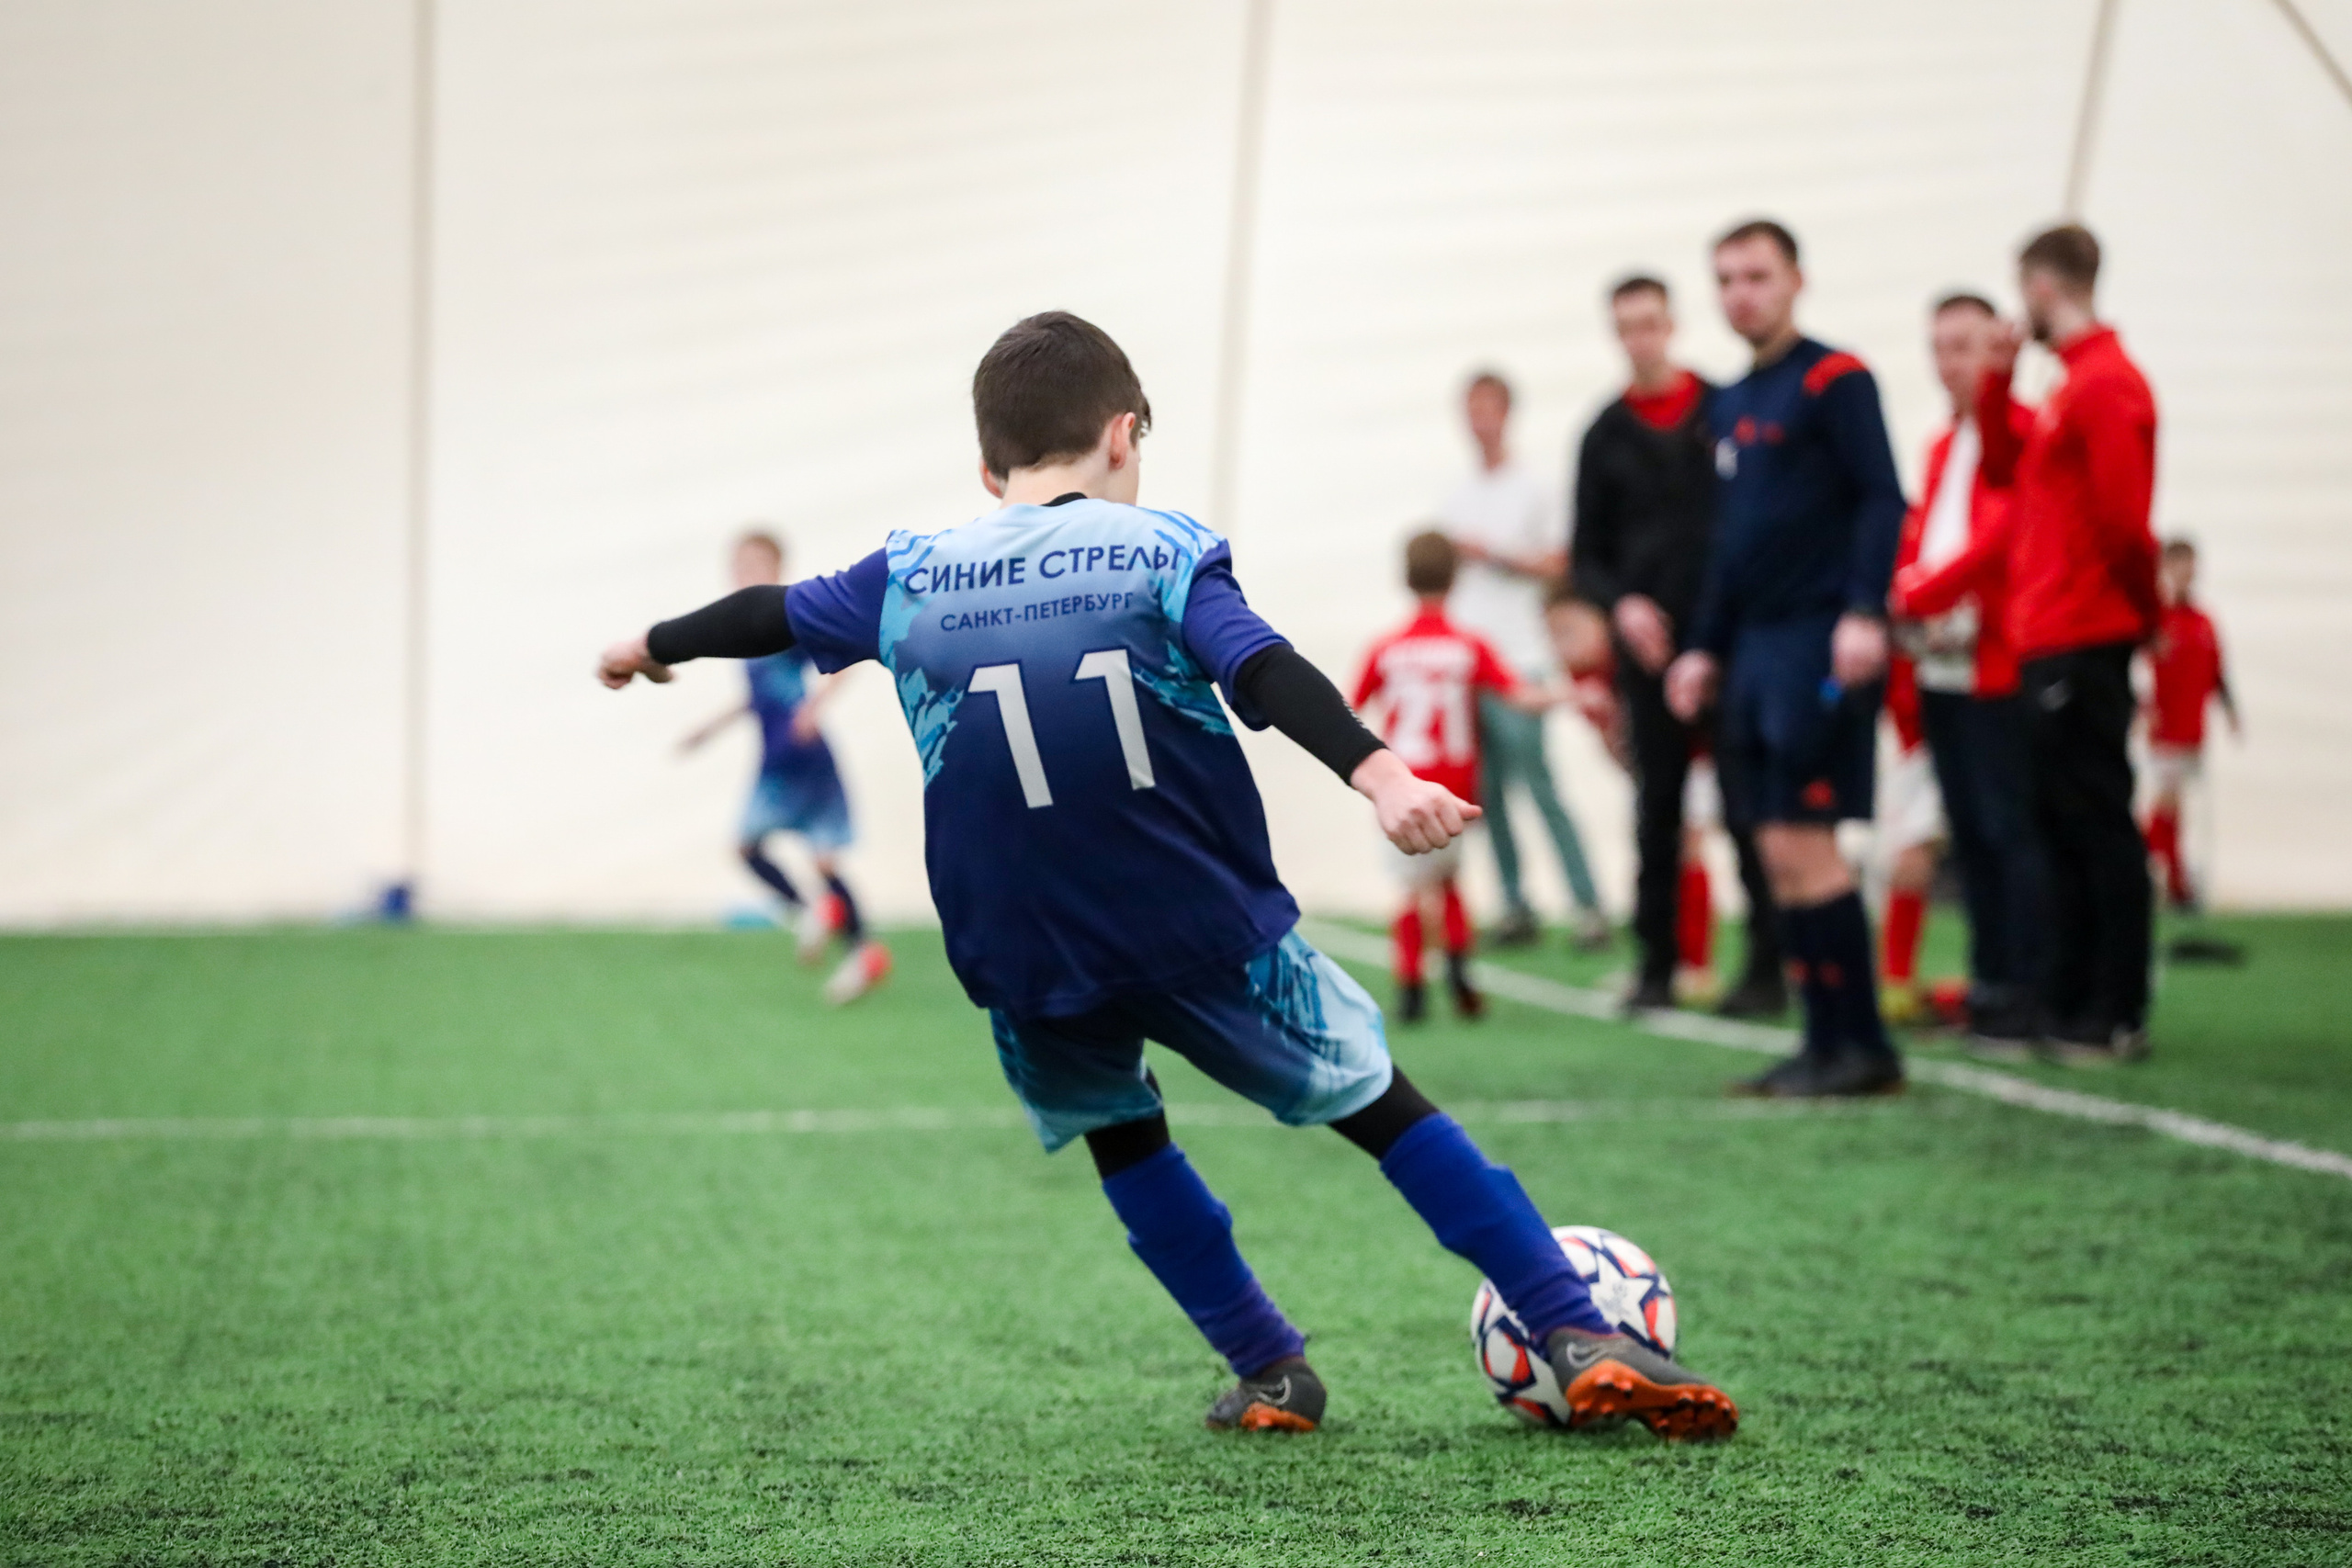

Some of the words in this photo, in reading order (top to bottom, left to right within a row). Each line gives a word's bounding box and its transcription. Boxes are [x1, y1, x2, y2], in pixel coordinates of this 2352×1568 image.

[906, 558, 1025, 594] СИНИЕ
[1039, 545, 1180, 579] СТРЕЛЫ
[940, 592, 1135, 632] САНКТ-ПЕТЕРБУРГ
[966, 648, 1157, 809] 11
